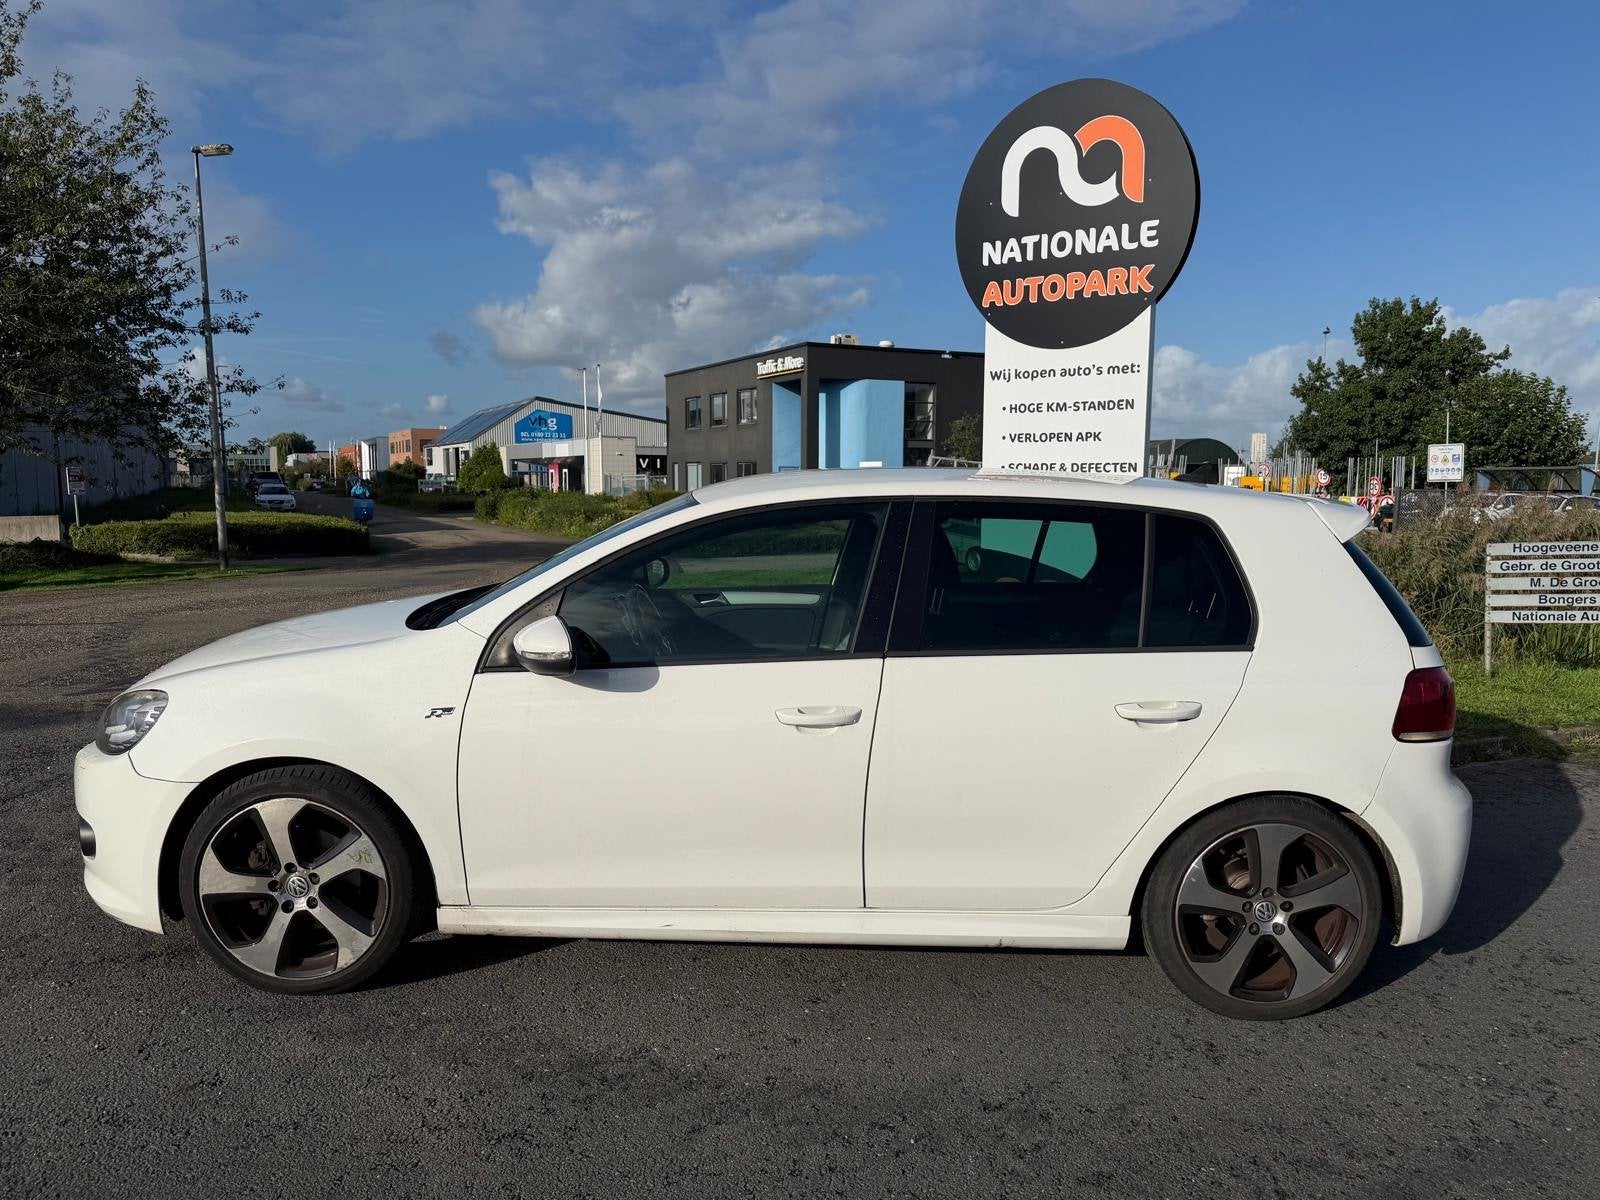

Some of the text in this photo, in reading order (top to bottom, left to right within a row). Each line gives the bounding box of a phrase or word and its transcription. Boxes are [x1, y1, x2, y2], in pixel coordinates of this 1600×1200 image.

[982, 219, 1160, 266] NATIONALE
[982, 264, 1155, 307] AUTOPARK
[990, 362, 1141, 383] Wij kopen auto's met:
[1009, 398, 1135, 413] HOGE KM-STANDEN
[528, 414, 557, 430] vhg
[1009, 431, 1102, 443] VERLOPEN APK
[1008, 462, 1138, 473] SCHADE & DEFECTEN
[1512, 542, 1599, 554] Hoogeveene
[1500, 560, 1600, 571] Gebr. de Groot
[1530, 577, 1600, 587] M. De Gro
[1538, 595, 1597, 606] Bongers
[1512, 612, 1599, 621] Nationale Au
